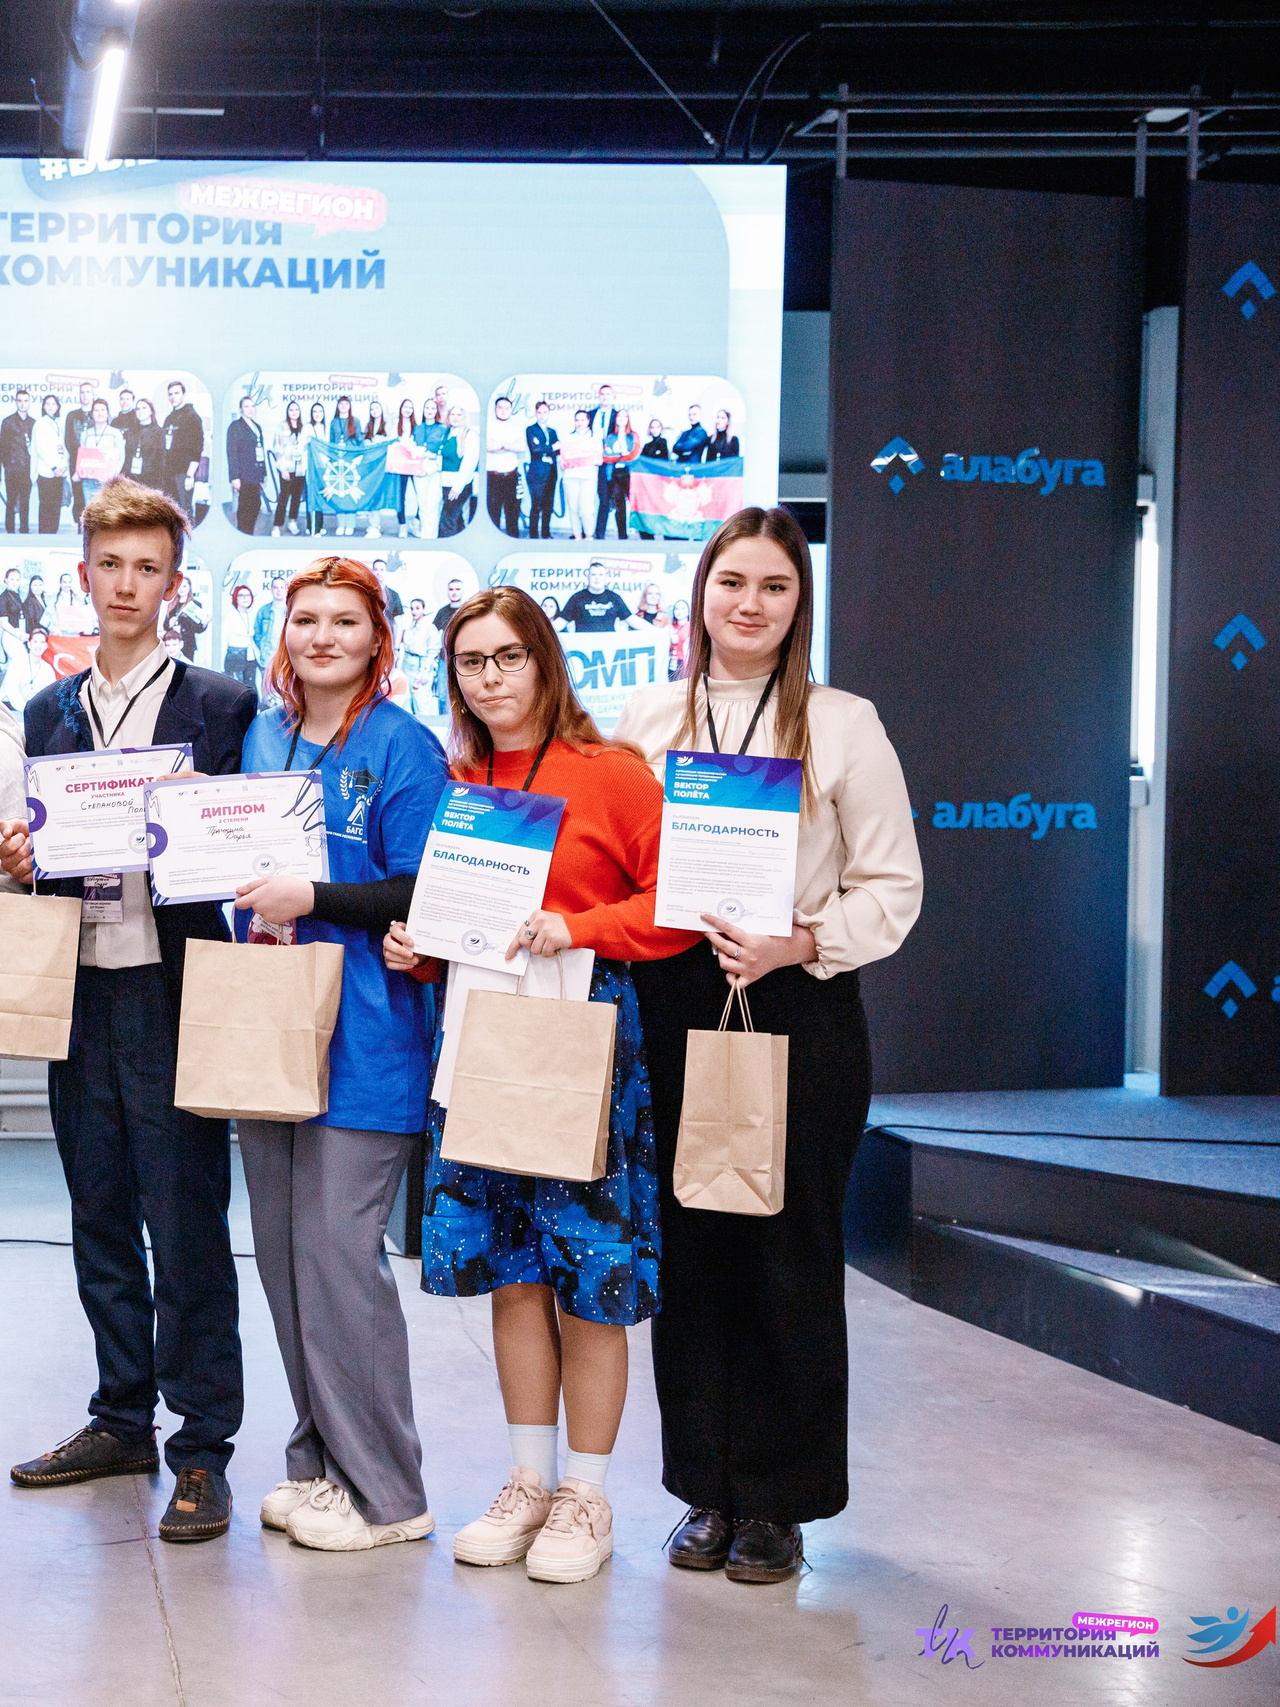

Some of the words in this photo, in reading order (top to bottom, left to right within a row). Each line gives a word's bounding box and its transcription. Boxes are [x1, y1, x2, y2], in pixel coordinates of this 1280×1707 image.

[189, 184, 374, 221] МЕЖРЕГИОН
[940, 447, 1106, 496] алабуга
[674, 782, 709, 790] ВЕКТОР
[91, 791, 125, 799] УЧАСТНИКА
[673, 790, 710, 800] ПОЛЁТА
[200, 803, 265, 820] ДИПЛОМ
[444, 810, 475, 821] ВЕКТОР
[932, 792, 1098, 840] алабуга
[345, 825, 363, 836] БАГС
[441, 819, 474, 831] ПОЛЁТА
[671, 821, 779, 838] БЛАГОДАРНОСТЬ
[433, 850, 530, 876] БЛАГОДАРНОСТЬ
